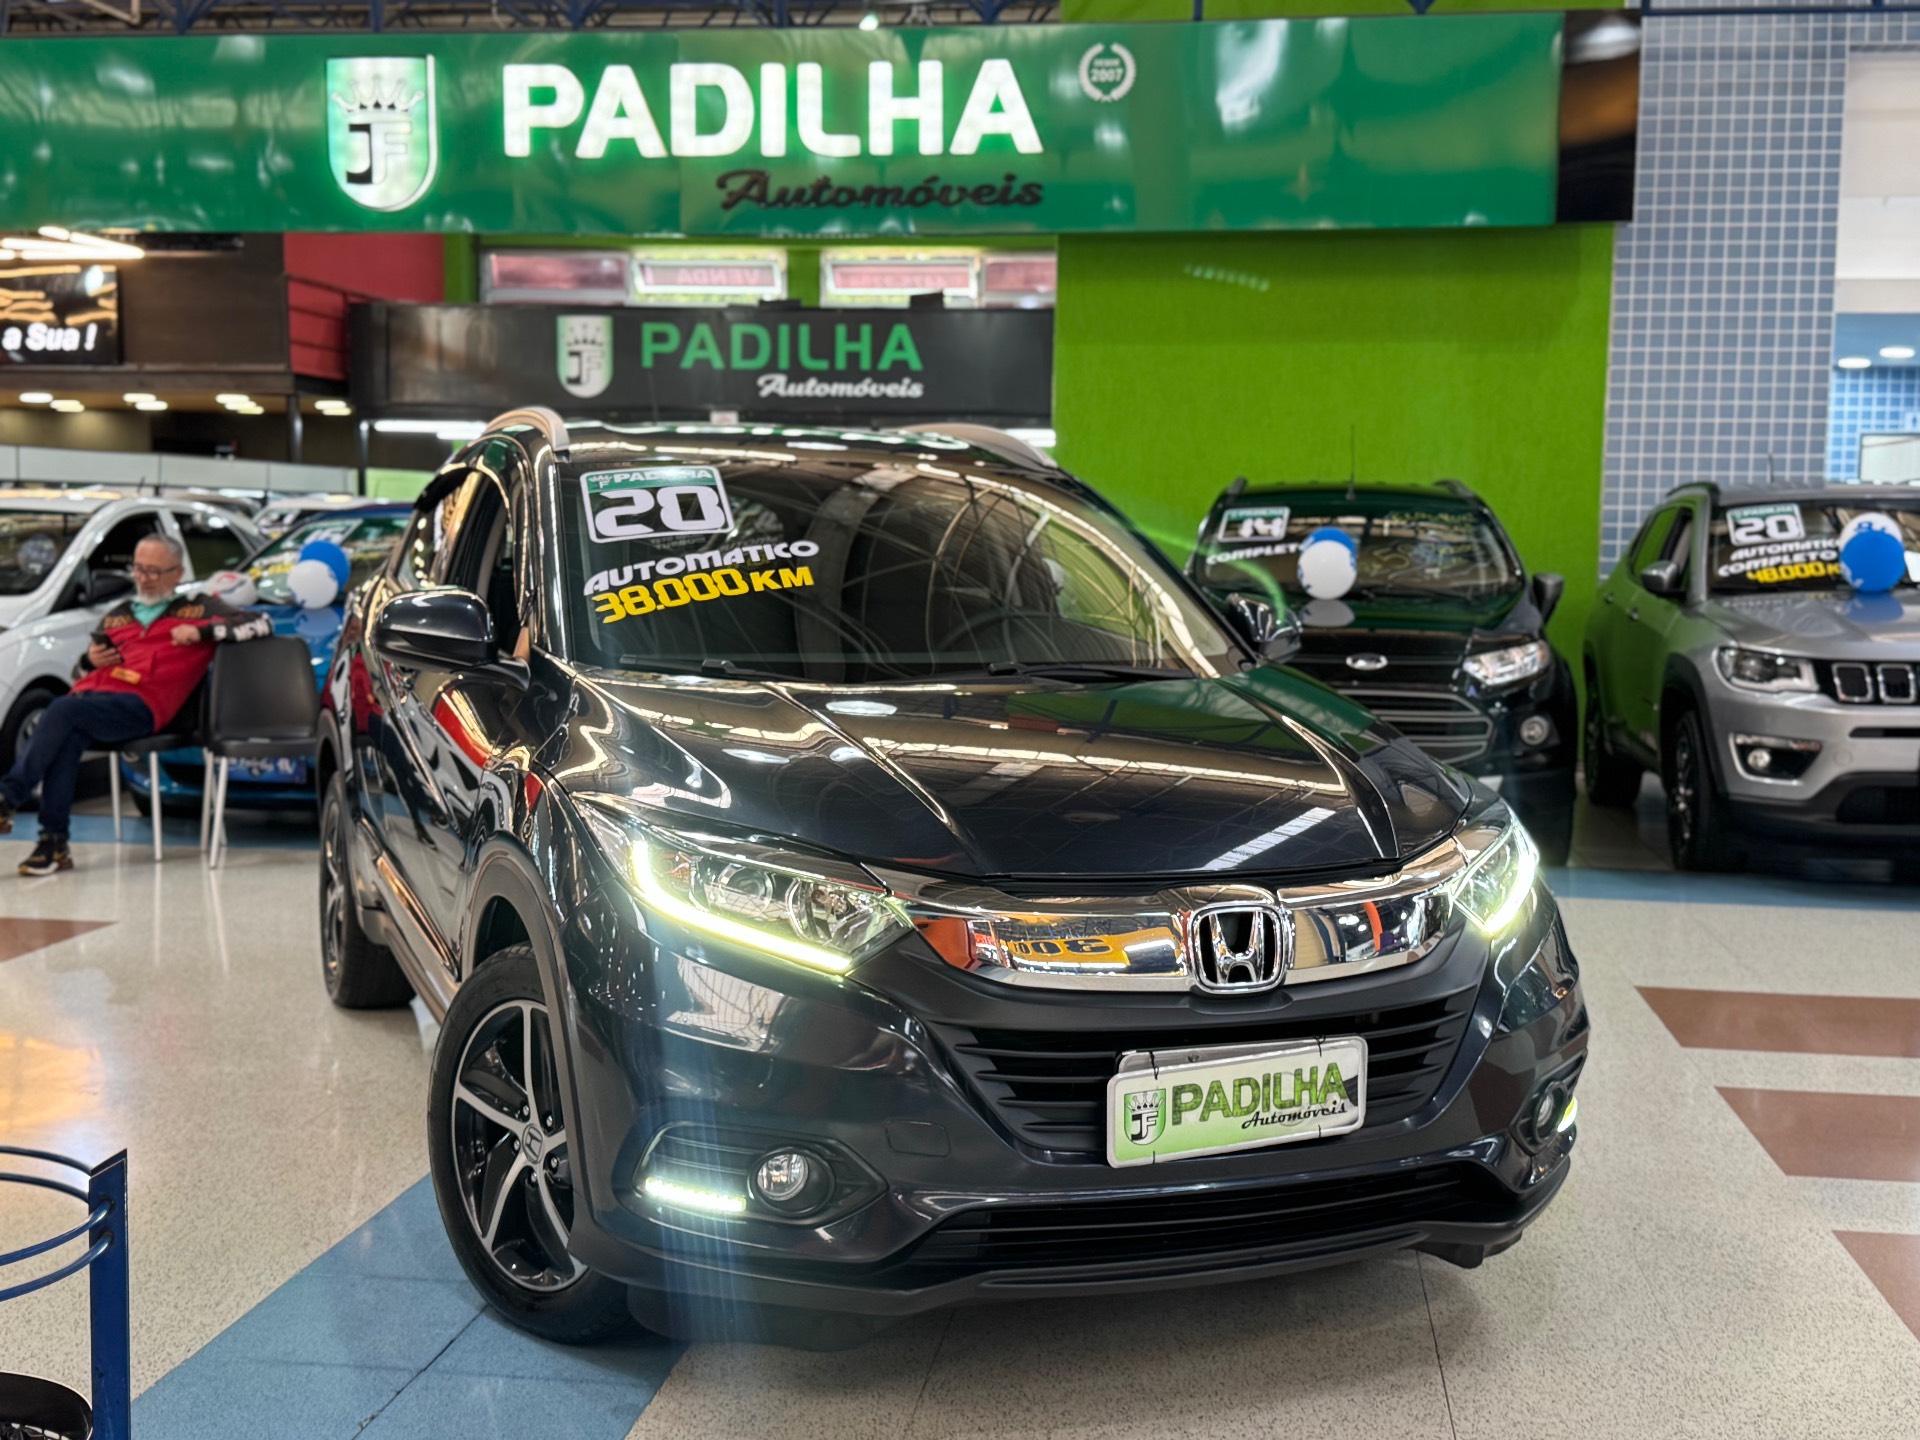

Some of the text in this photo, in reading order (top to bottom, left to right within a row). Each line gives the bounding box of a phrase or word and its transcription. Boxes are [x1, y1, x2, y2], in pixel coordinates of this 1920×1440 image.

[1090, 68, 1123, 83] 2007
[502, 59, 1043, 159] PADILHA
[346, 121, 412, 185] JF
[716, 169, 1044, 210] Automóveis
[2, 327, 22, 351] a
[25, 322, 80, 351] Sua
[641, 322, 924, 371] PADILHA
[757, 373, 924, 399] Automóveis
[595, 485, 726, 537] 20
[1734, 515, 1800, 543] 20
[583, 540, 820, 596] AUTOMATICO
[1206, 542, 1304, 565] COMPLET
[1718, 549, 1839, 577] COMPLETO
[1731, 538, 1842, 562] AUTOMATIC
[590, 565, 816, 624] 38.000 KM
[1171, 1062, 1349, 1126] PADILHA
[1241, 1099, 1348, 1130] Automóveis
